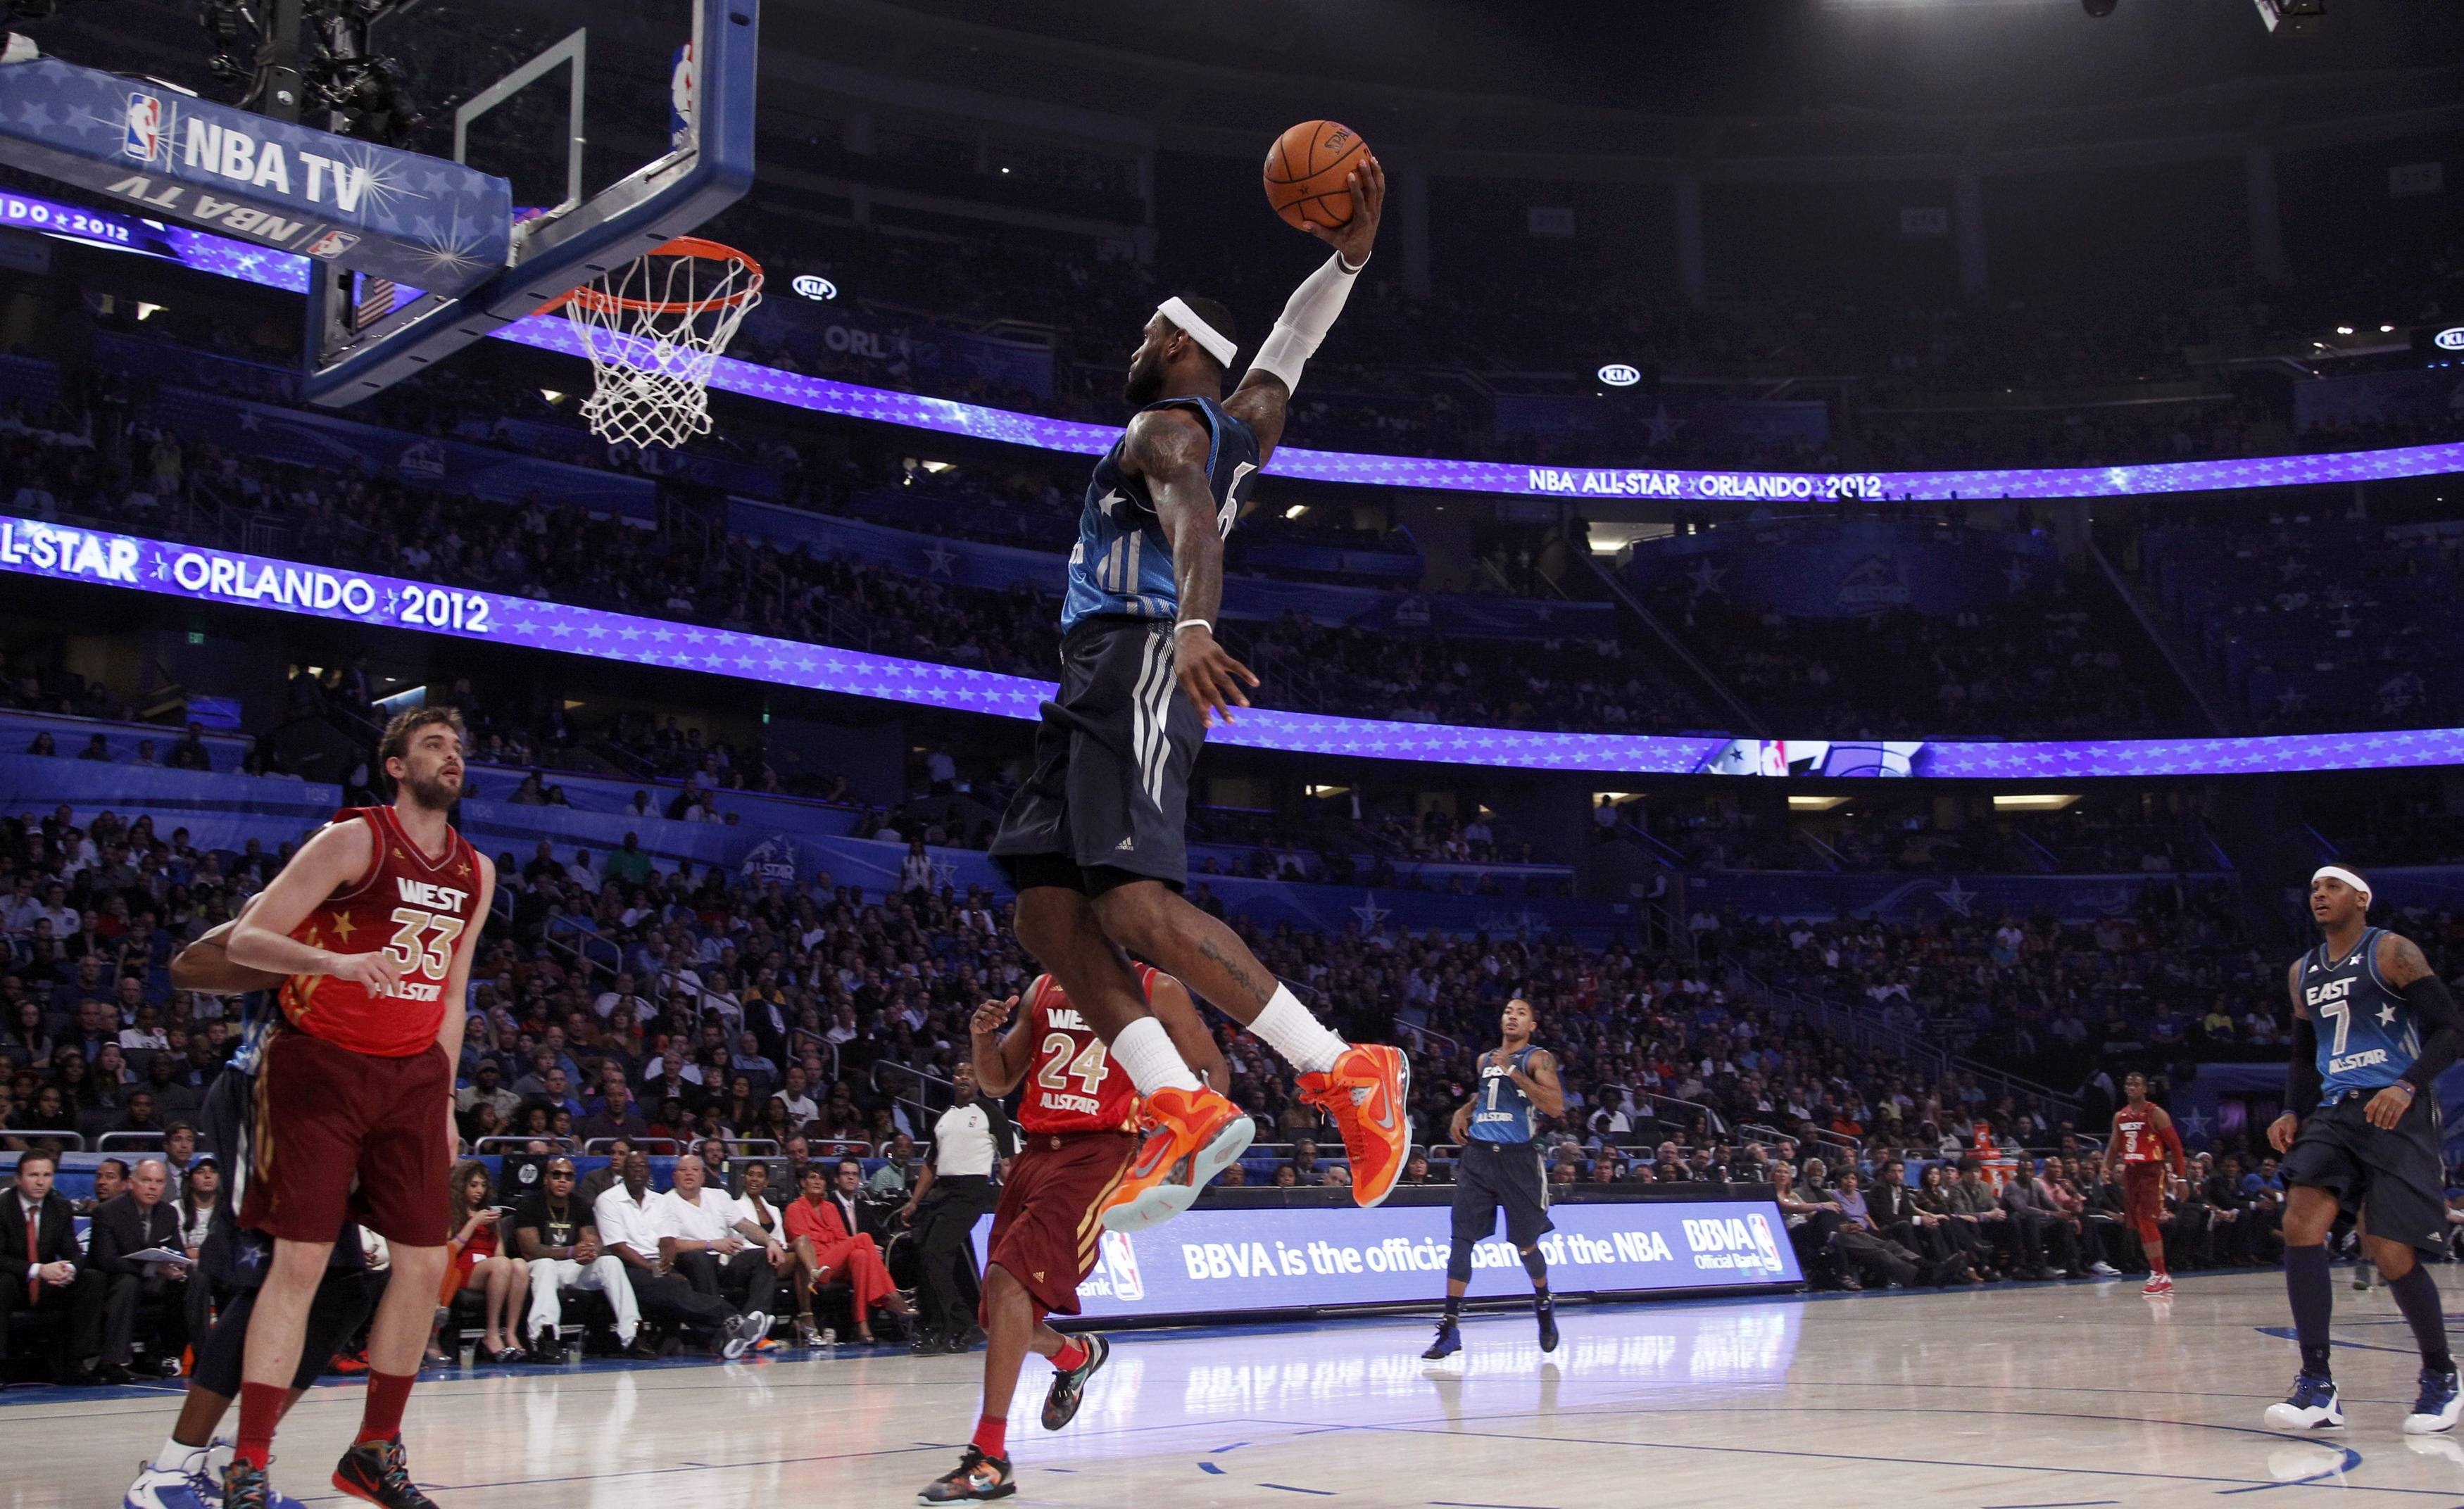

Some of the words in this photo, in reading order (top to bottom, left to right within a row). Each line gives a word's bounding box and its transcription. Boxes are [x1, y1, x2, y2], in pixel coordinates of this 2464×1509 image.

[184, 117, 290, 194] NBA
[299, 151, 366, 212] TV
[106, 176, 185, 209] TV
[73, 214, 130, 241] 2012
[193, 195, 304, 241] NBA
[800, 279, 829, 296] KIA
[1605, 369, 1633, 381] KIA
[1528, 468, 1576, 493] NBA
[1581, 470, 1681, 495] ALL-STAR
[1699, 473, 1811, 498] ORLANDO
[1825, 475, 1882, 499] 2012
[1, 523, 139, 583] L-STAR
[173, 552, 377, 615] ORLANDO
[400, 585, 490, 633] 2012
[396, 876, 470, 913] WEST
[382, 907, 465, 980] 33
[2306, 976, 2358, 1006] EAST
[1046, 1008, 1093, 1032] WE
[2320, 999, 2350, 1056] 7
[1038, 1033, 1109, 1095] 24
[1487, 1078, 1500, 1111] 1
[2125, 1130, 2138, 1153] 3
[1681, 1218, 1756, 1252] BBVA
[1181, 1242, 1278, 1280] BBVA
[1276, 1241, 1309, 1276] is
[1308, 1240, 1363, 1275] the
[1366, 1237, 1452, 1272] officia
[1470, 1242, 1522, 1269] ban
[1543, 1234, 1565, 1266] of
[1567, 1233, 1615, 1265] the
[1612, 1231, 1673, 1263] NBA
[1694, 1254, 1735, 1270] Official
[1733, 1252, 1764, 1268] Bank
